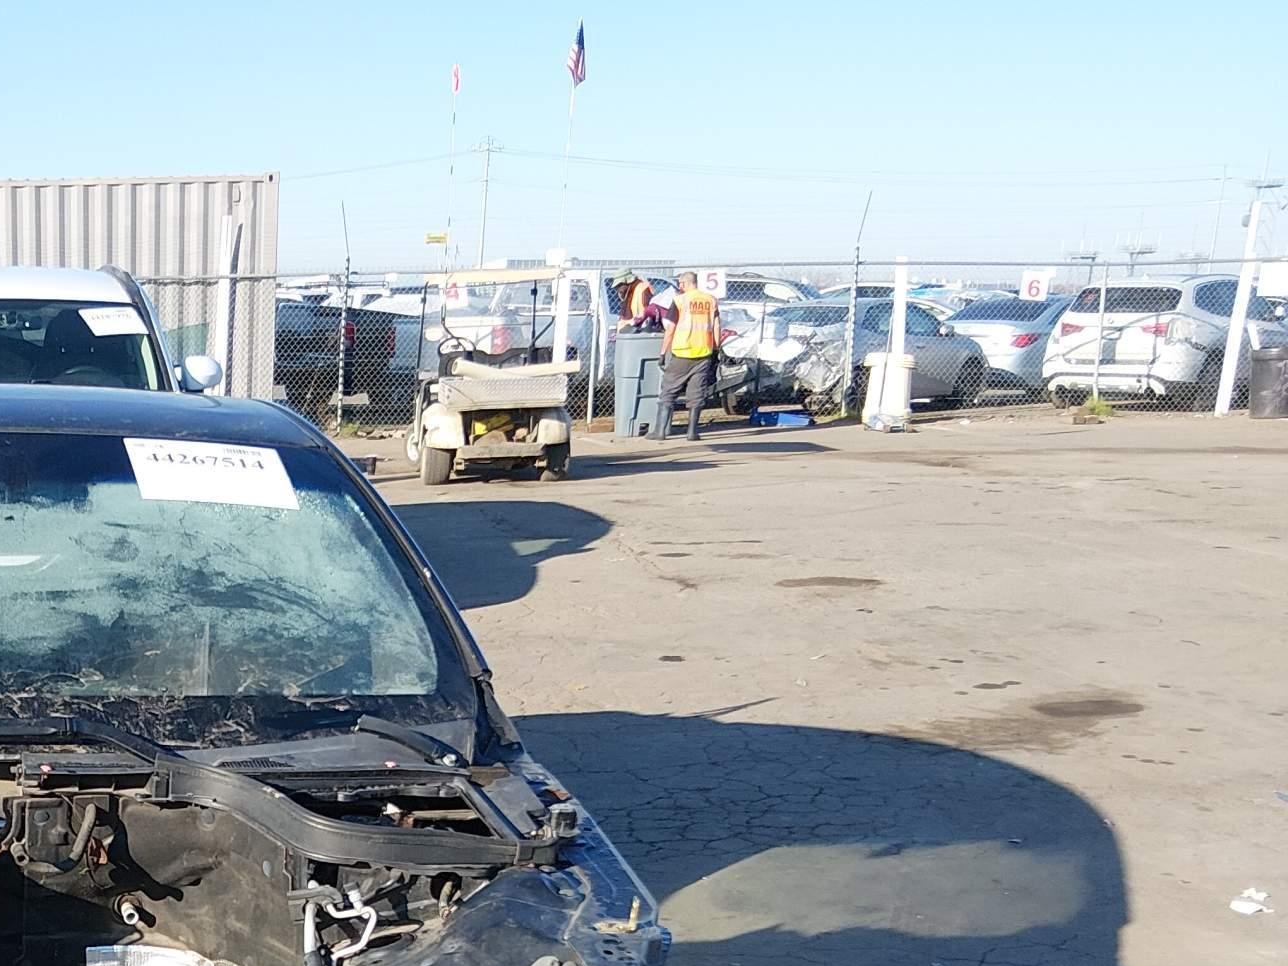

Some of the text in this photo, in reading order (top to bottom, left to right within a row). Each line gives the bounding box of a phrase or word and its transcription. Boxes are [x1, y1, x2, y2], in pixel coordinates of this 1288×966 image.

[706, 272, 719, 291] 5
[1028, 279, 1041, 298] 6
[145, 452, 265, 470] 44267514
